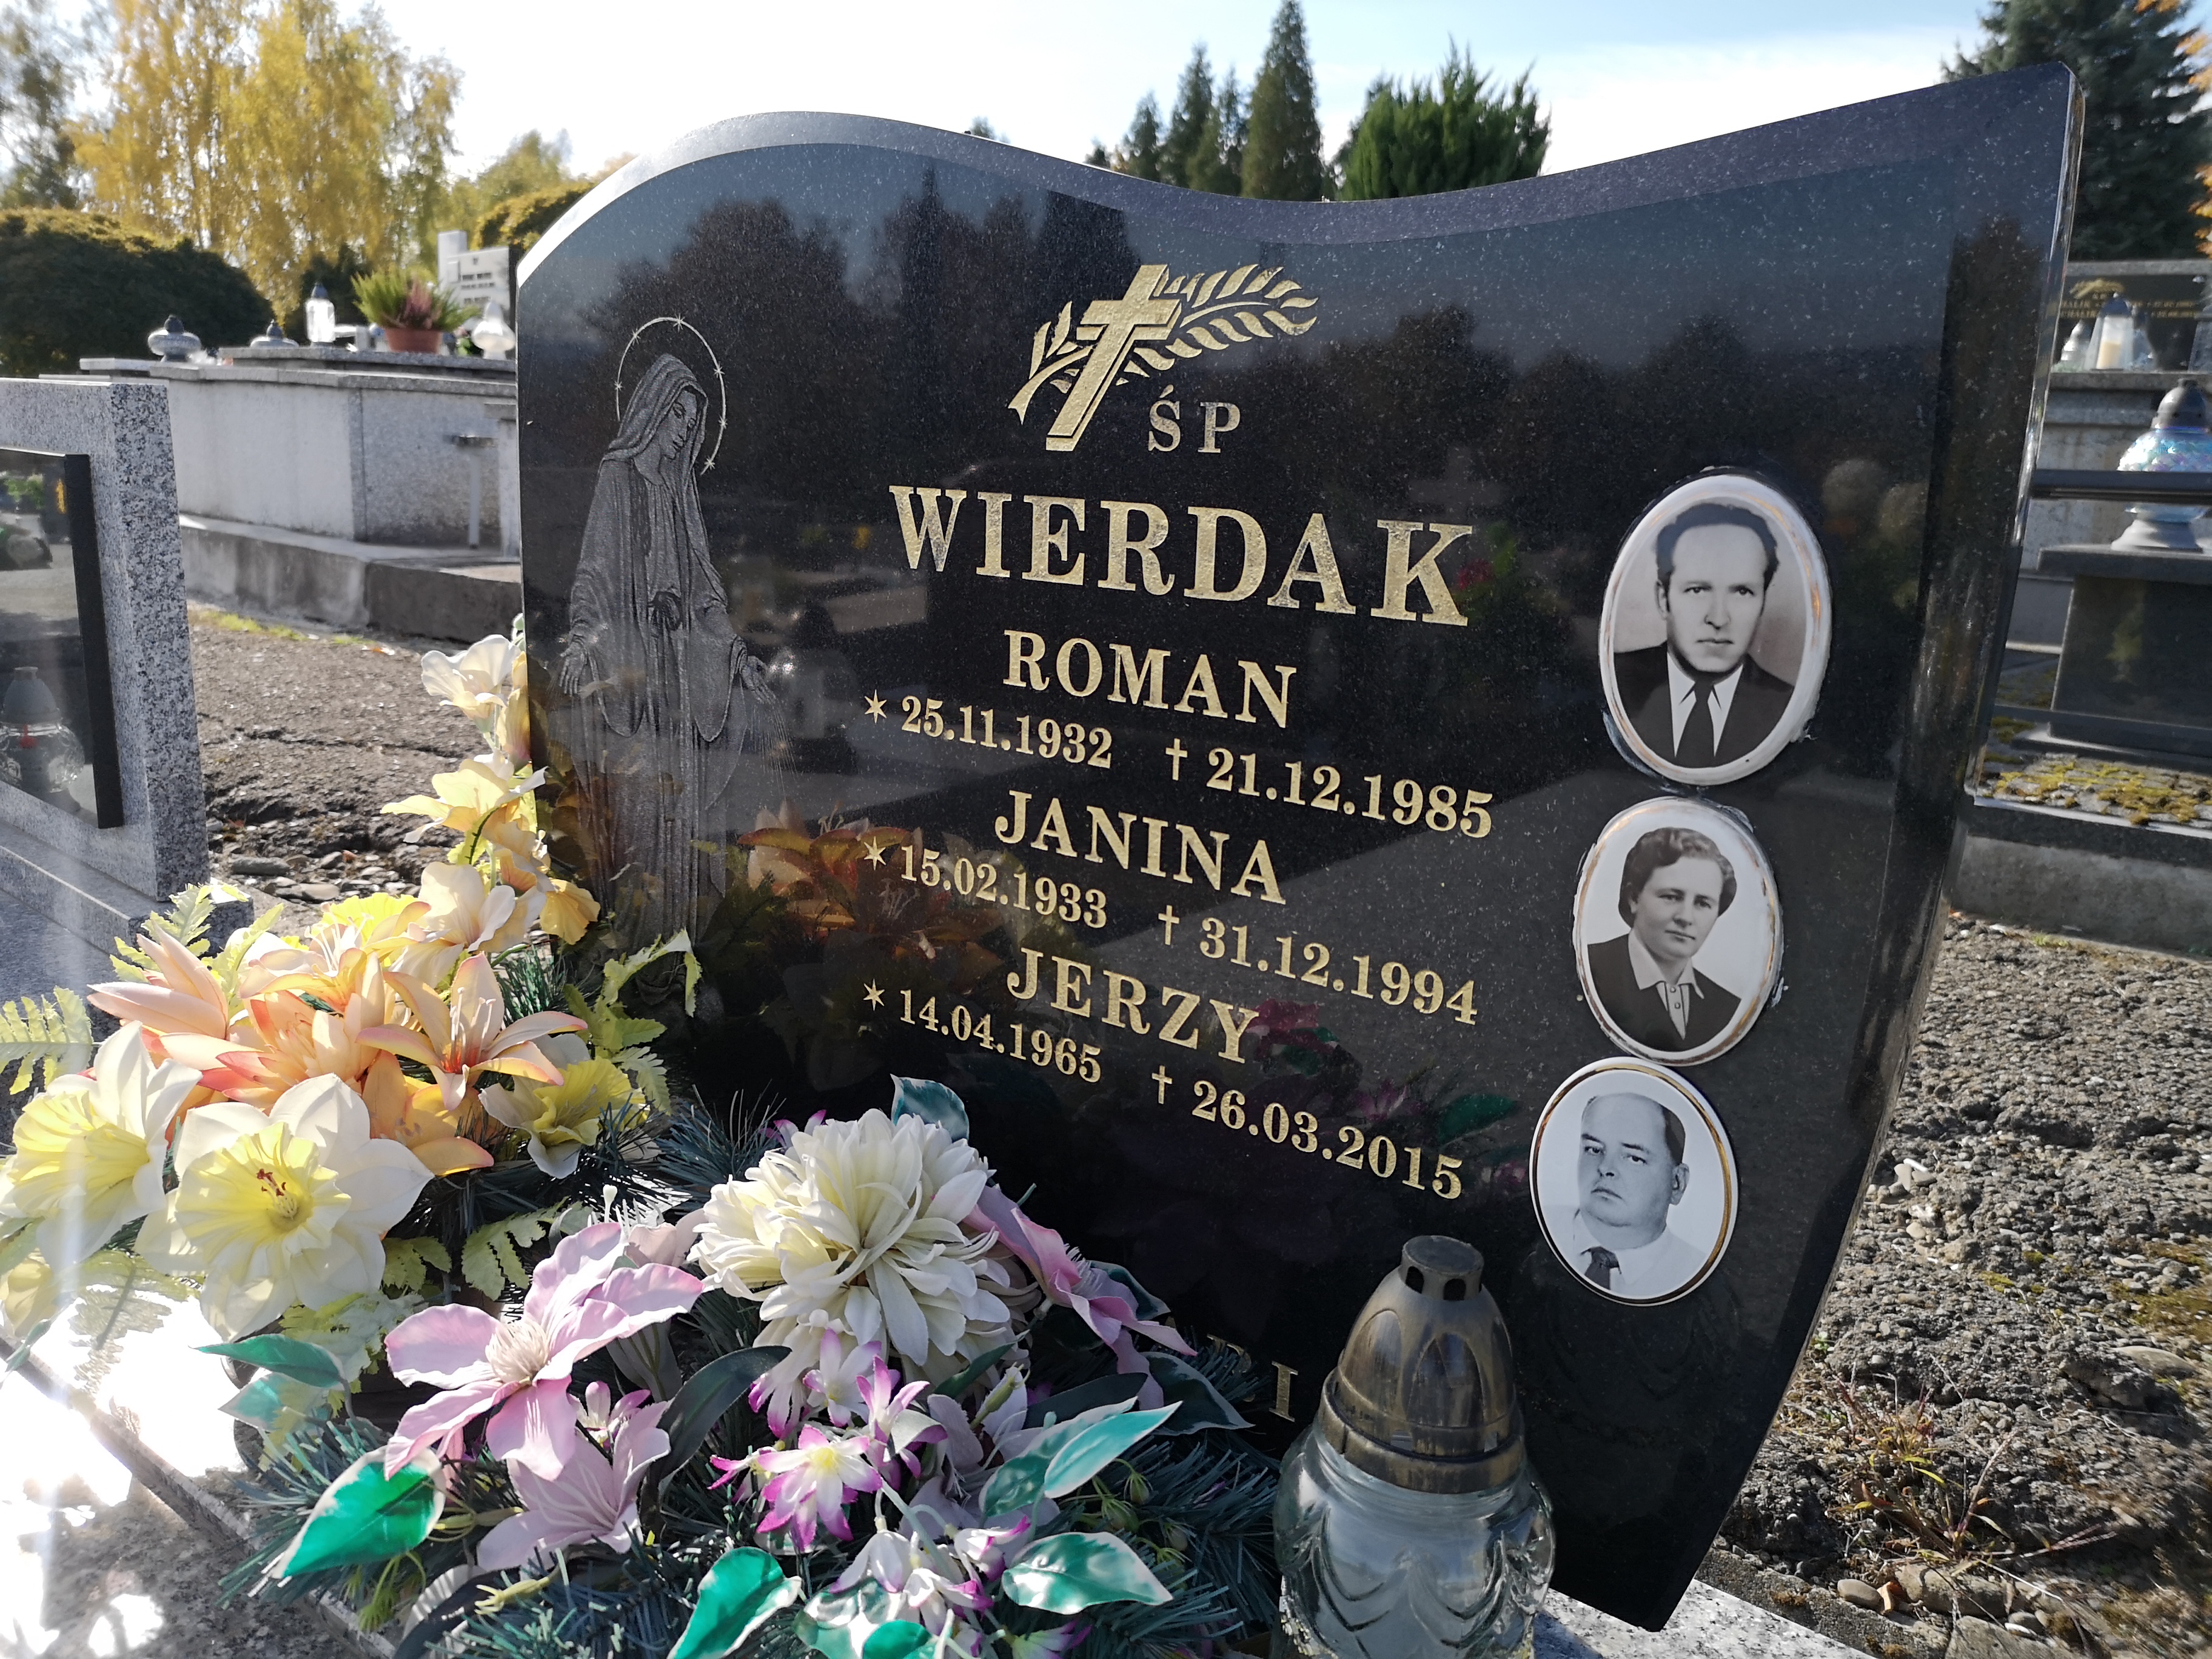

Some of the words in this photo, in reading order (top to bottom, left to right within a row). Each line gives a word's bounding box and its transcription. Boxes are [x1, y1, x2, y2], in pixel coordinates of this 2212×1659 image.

[889, 485, 1473, 626] WIERDAK
[1003, 629, 1297, 728] ROMAN
[902, 695, 1112, 769] 25.11.1932
[1206, 748, 1493, 838] 21.12.1985
[994, 789, 1286, 905] JANINA
[901, 845, 1107, 928] 15.02.1933
[1199, 917, 1478, 1025] 31.12.1994
[1007, 947, 1259, 1064] JERZY
[900, 990, 1101, 1083] 14.04.1965
[1191, 1080, 1463, 1199] 26.03.2015
